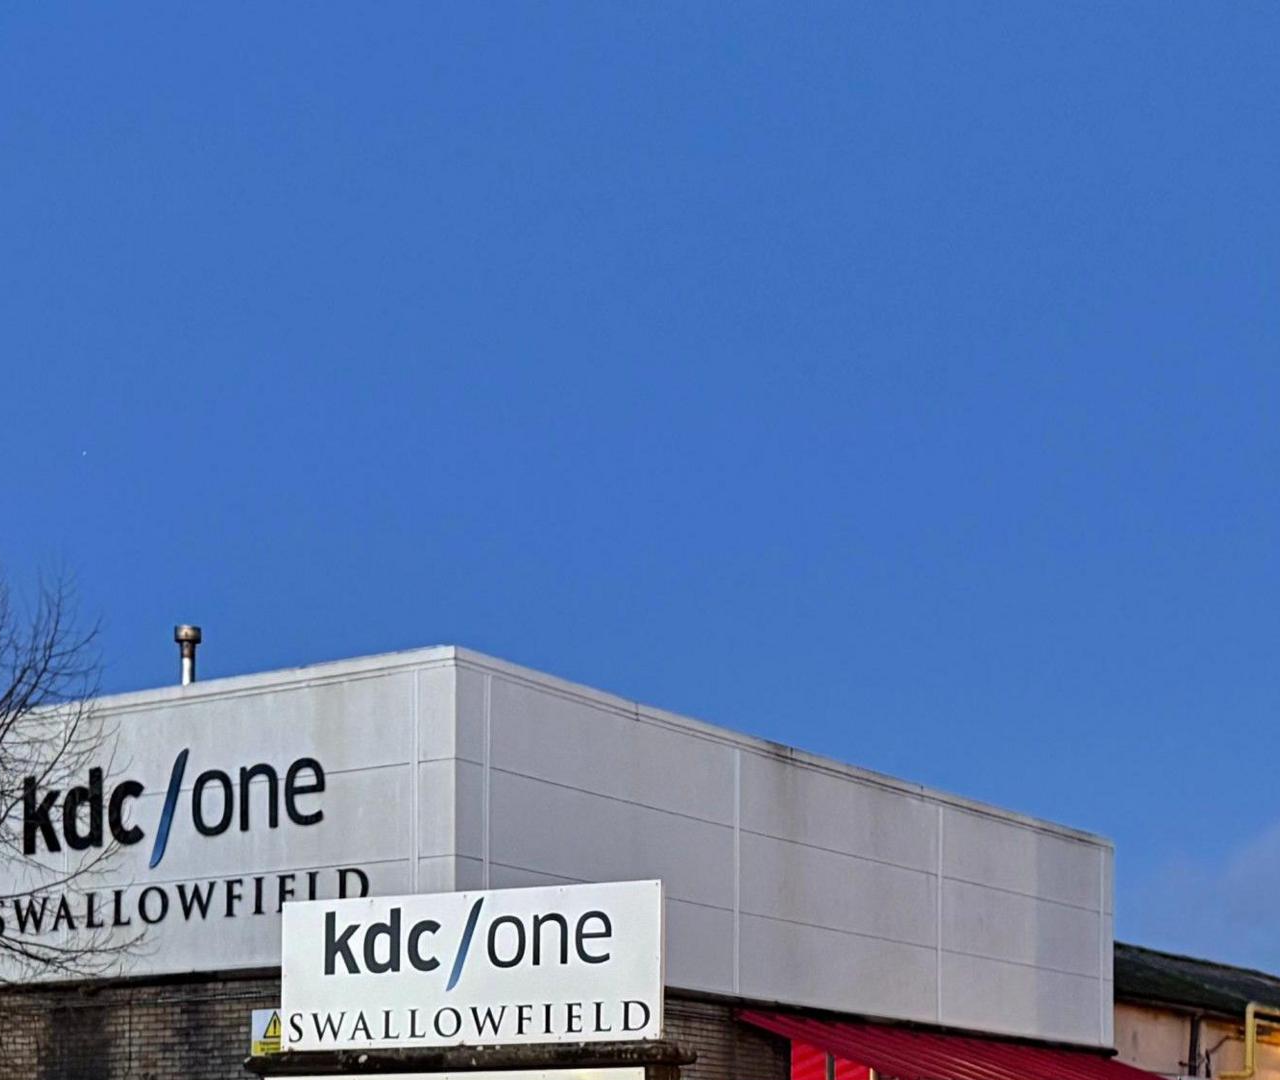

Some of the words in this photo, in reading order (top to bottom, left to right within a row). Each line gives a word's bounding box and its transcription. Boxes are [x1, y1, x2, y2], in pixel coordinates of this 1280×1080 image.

[22, 748, 326, 869] kdc/one
[324, 897, 612, 992] kdc/one
[288, 1000, 651, 1043] SWALLOWFIELD
